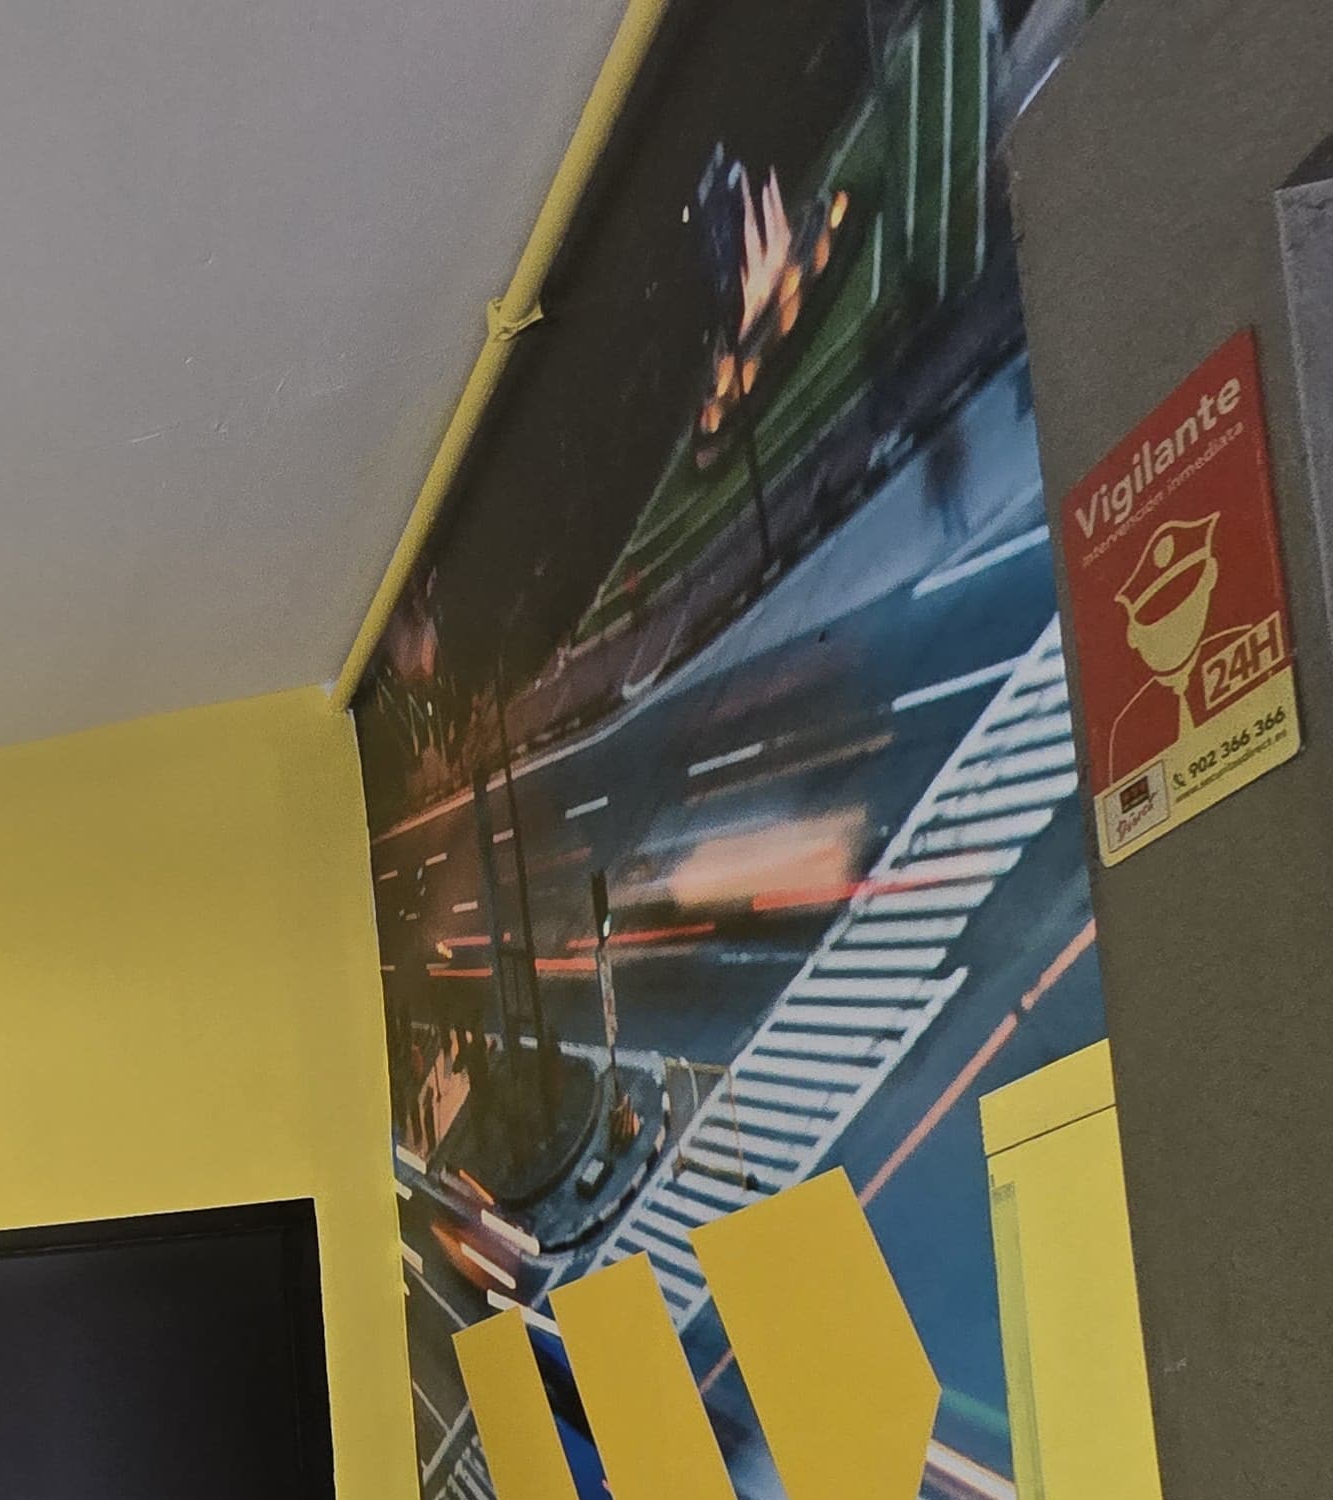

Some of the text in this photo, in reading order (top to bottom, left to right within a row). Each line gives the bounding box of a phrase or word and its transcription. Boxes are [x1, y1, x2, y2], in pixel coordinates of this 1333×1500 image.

[1074, 377, 1241, 539] Vigilante
[1206, 617, 1280, 703] 24H
[1188, 751, 1218, 778] 902
[1253, 706, 1286, 736] 366
